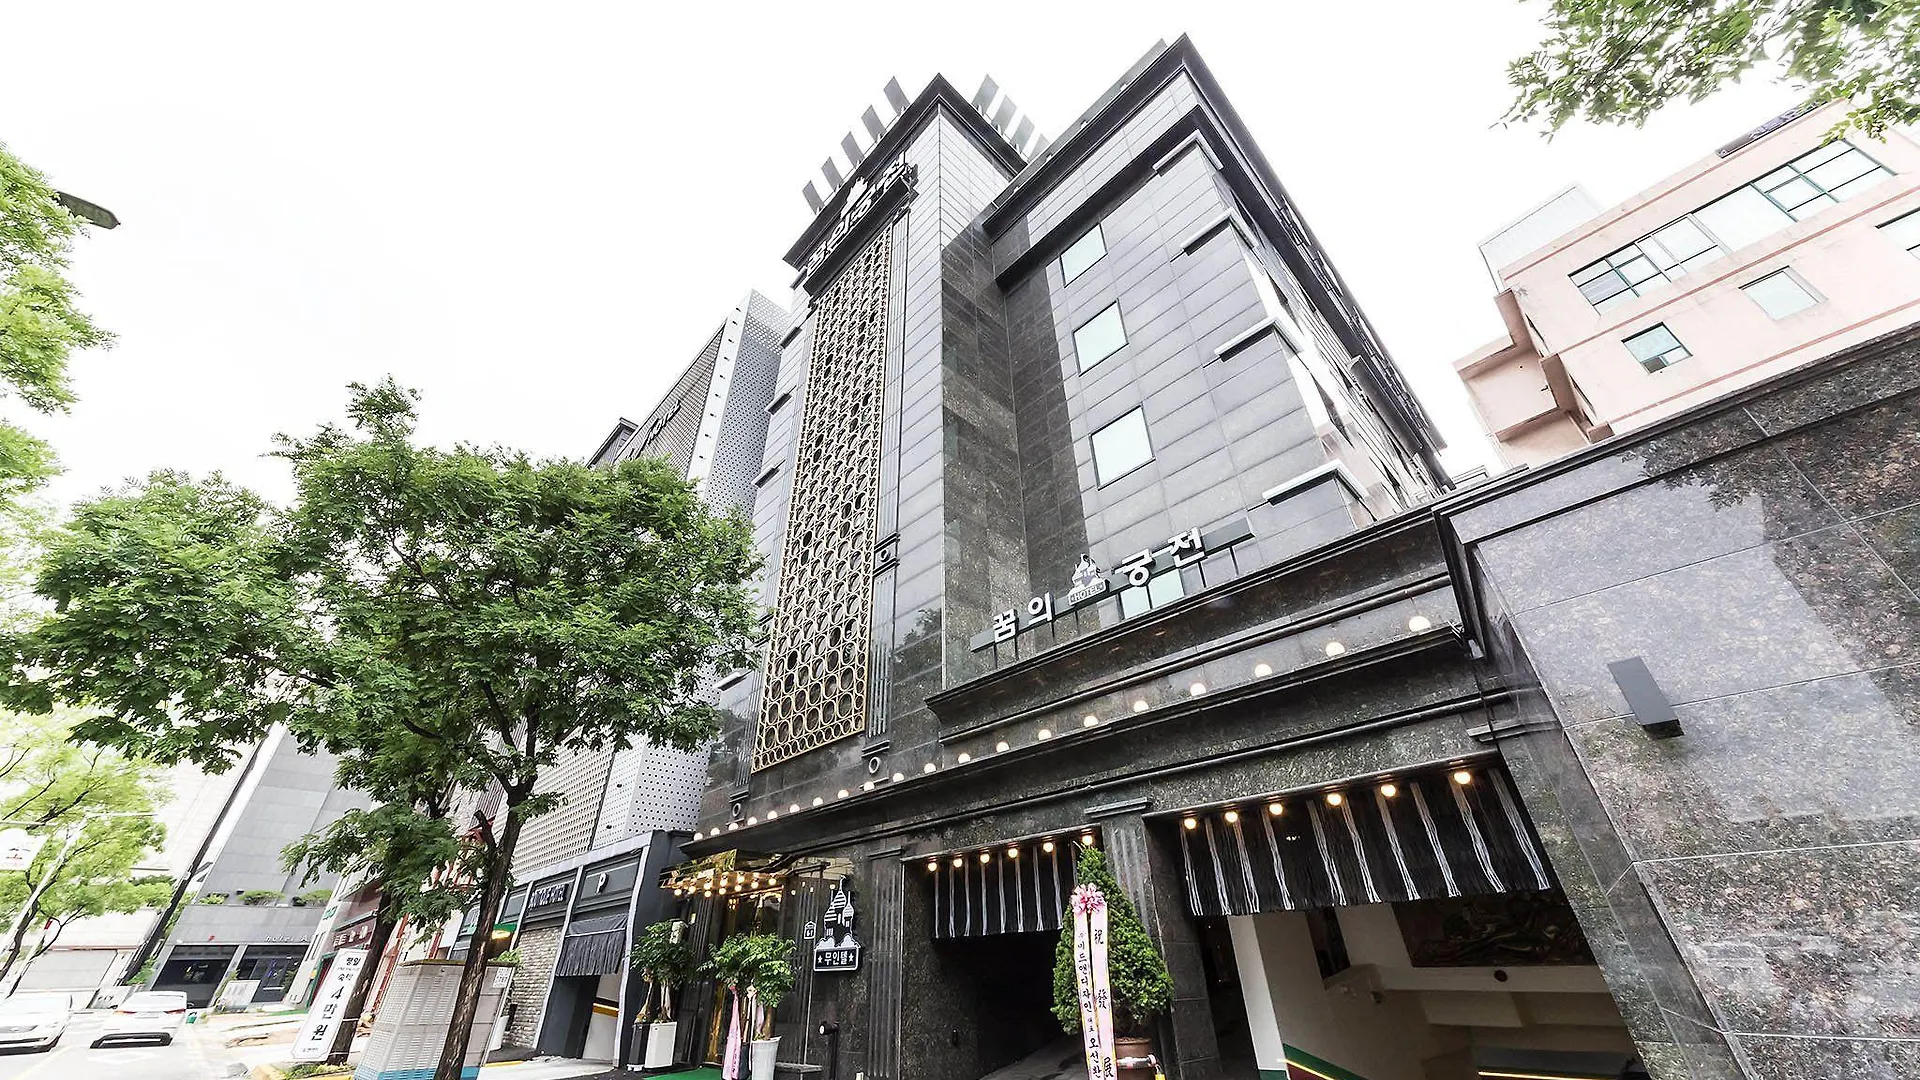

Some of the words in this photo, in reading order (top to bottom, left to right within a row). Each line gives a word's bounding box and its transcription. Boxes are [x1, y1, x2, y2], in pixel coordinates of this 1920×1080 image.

[993, 591, 1054, 643] 꿈의
[1113, 526, 1206, 588] 궁전
[1074, 585, 1099, 601] HOTEL
[596, 872, 608, 896] P
[824, 950, 848, 966] 무인텔
